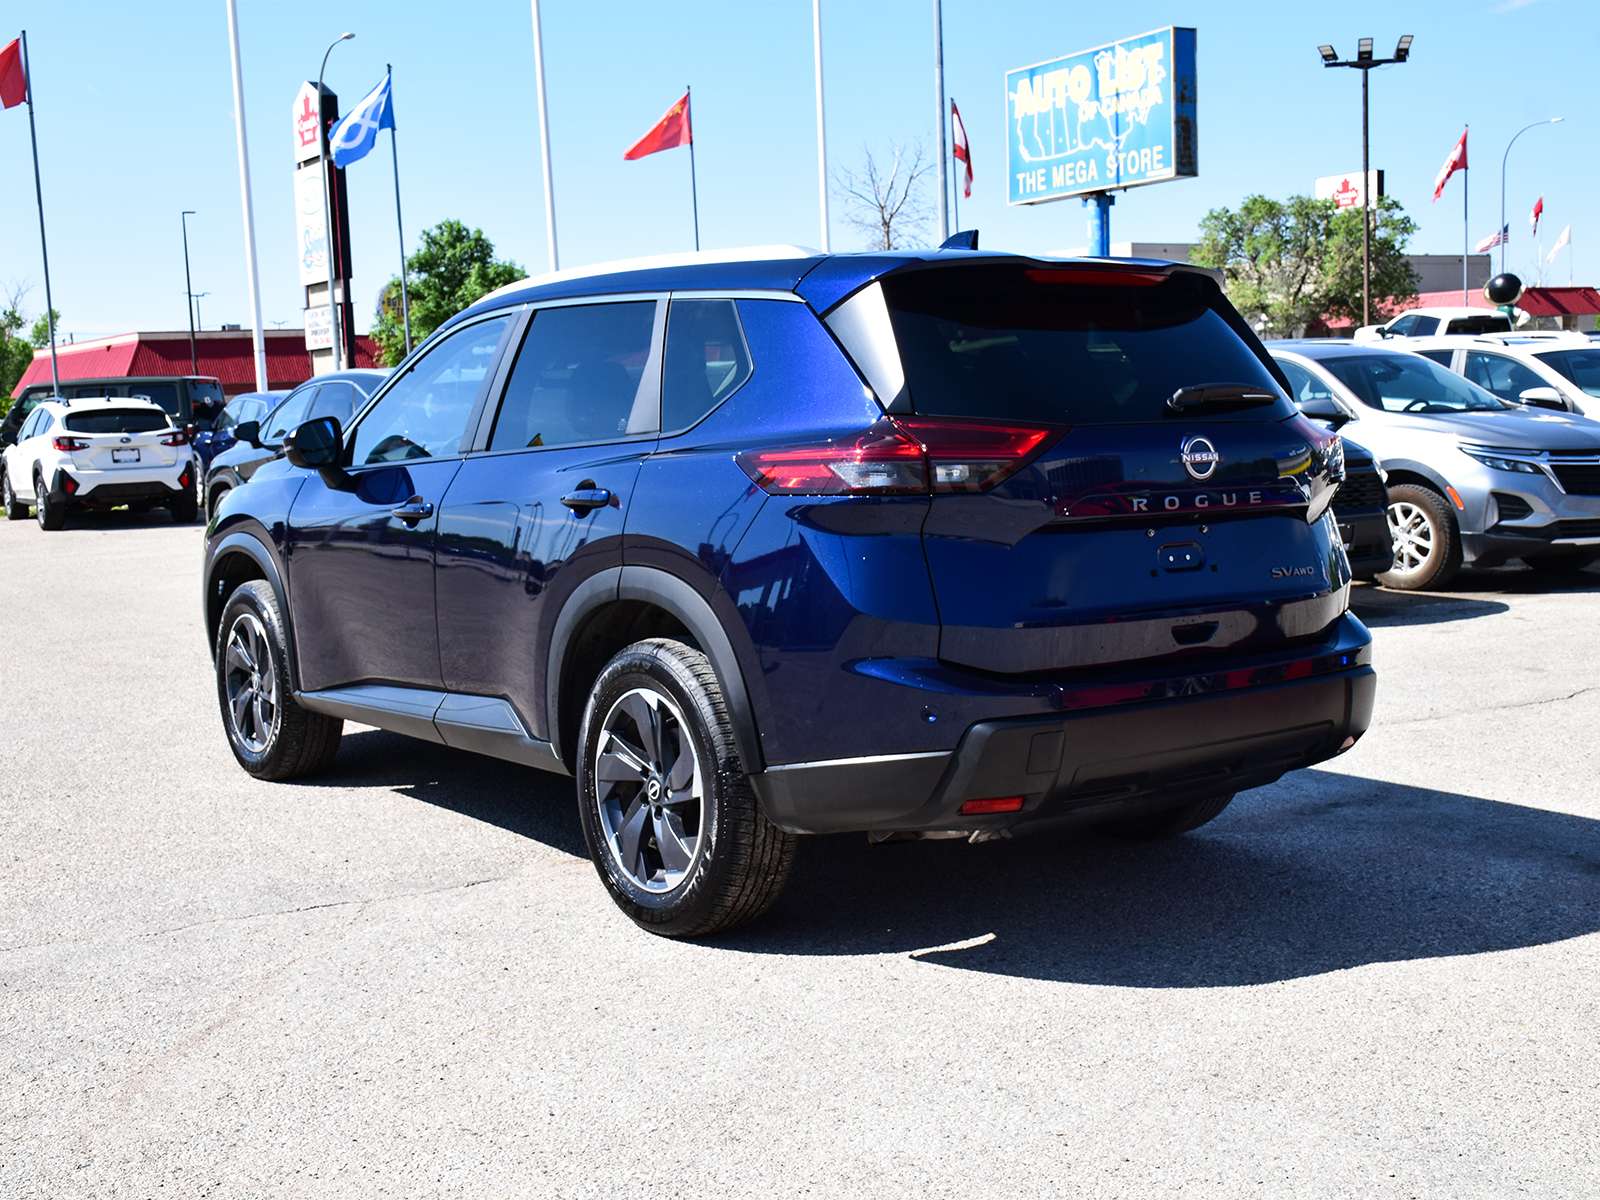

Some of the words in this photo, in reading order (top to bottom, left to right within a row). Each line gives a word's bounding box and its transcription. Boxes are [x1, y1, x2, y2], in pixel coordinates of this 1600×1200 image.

[1014, 64, 1091, 118] AUTO
[1016, 168, 1047, 194] THE
[1052, 159, 1098, 188] MEGA
[1106, 145, 1163, 178] STORE
[1182, 452, 1219, 462] NISSAN
[1132, 491, 1262, 511] ROGUE
